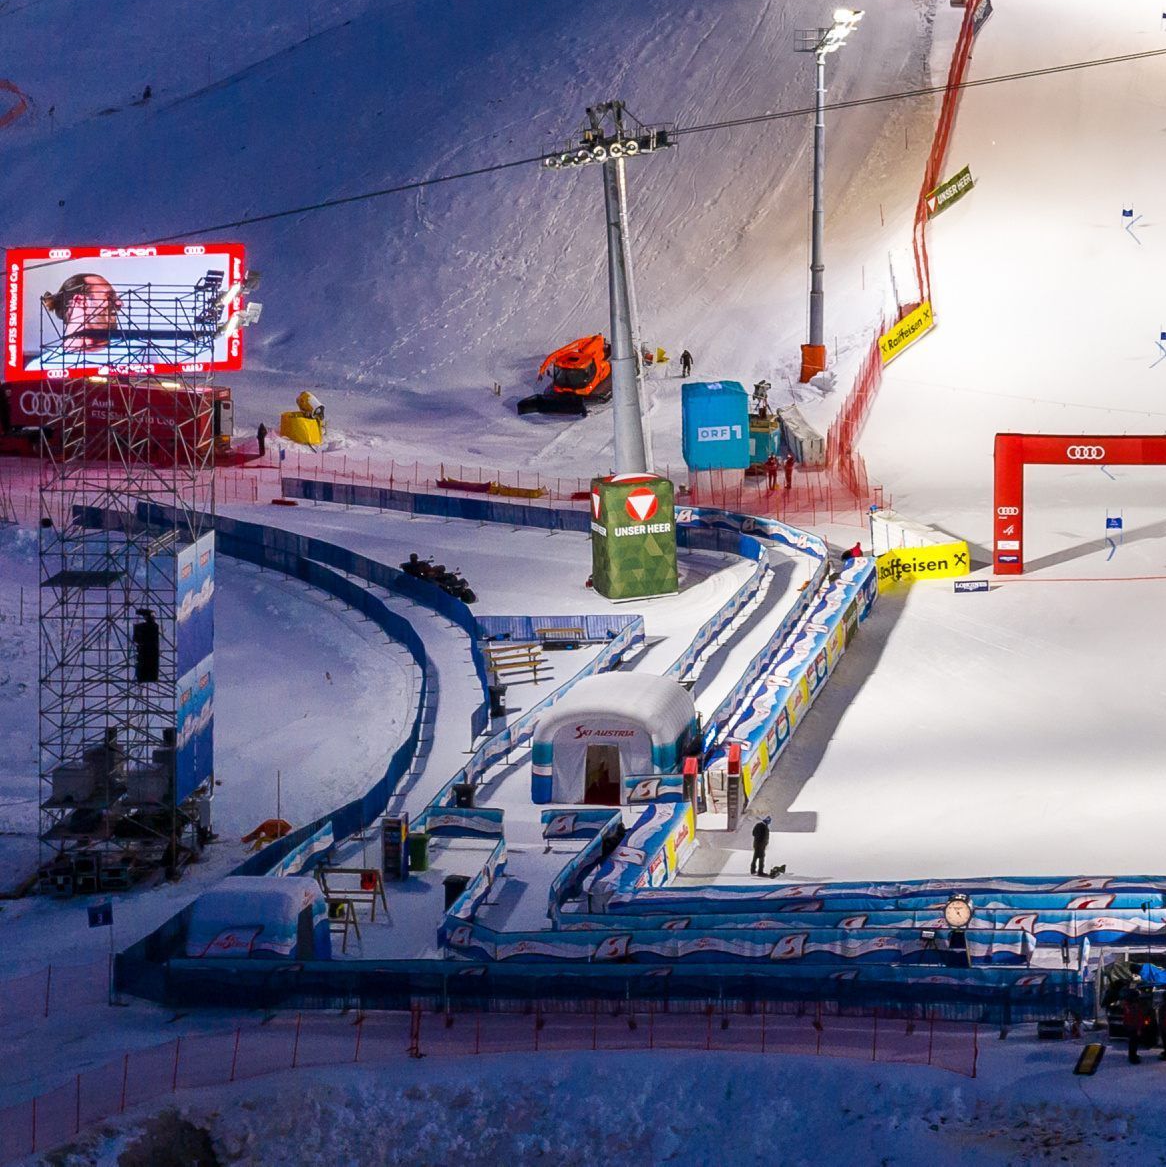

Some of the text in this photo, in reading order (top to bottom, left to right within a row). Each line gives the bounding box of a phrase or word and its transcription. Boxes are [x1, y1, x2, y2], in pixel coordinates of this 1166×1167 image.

[938, 173, 972, 205] UNSER HEER
[8, 264, 19, 366] Audi FIS Ski World Cup
[888, 318, 923, 351] Raiffeisen
[92, 399, 114, 408] Audi
[700, 425, 742, 439] ORF 1
[614, 523, 671, 537] UNSER HEER
